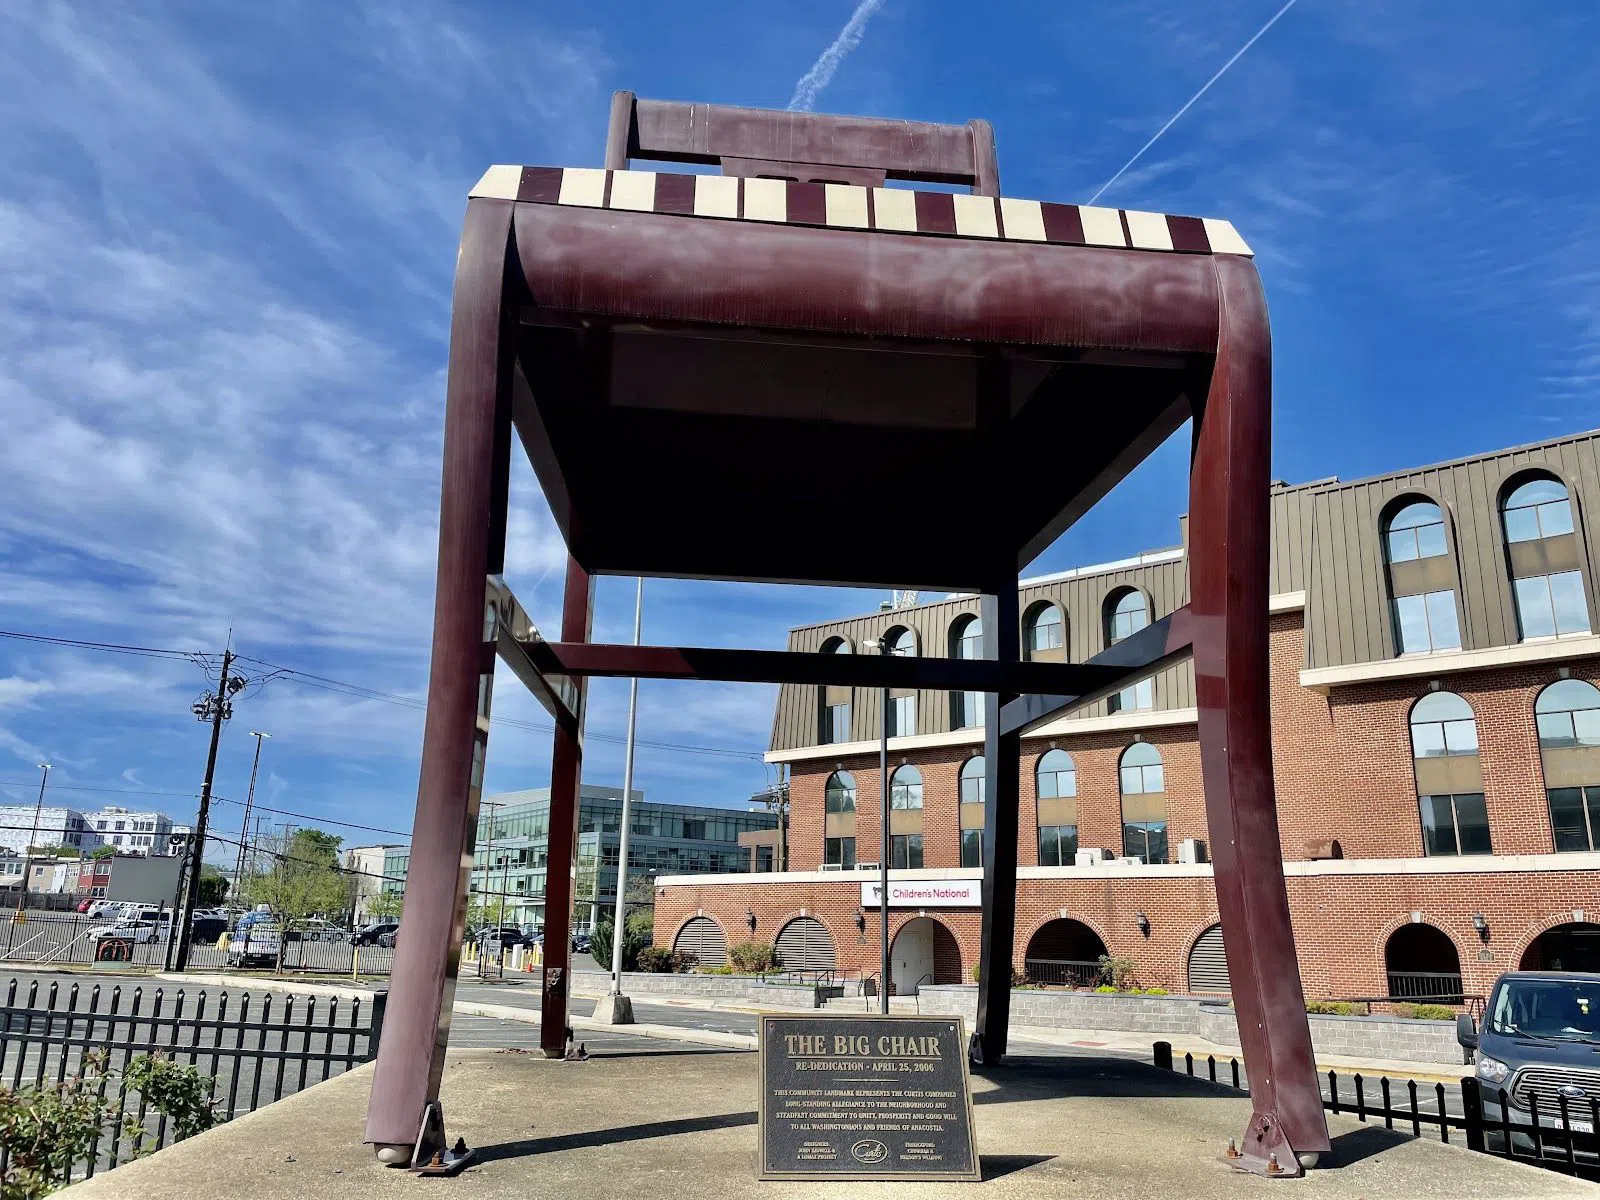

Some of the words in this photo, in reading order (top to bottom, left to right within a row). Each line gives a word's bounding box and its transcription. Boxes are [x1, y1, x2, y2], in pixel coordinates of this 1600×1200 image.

[893, 889, 932, 898] Children's
[933, 889, 970, 898] National
[785, 1035, 827, 1056] THE
[834, 1035, 870, 1056] BIG
[878, 1036, 942, 1056] CHAIR
[796, 1062, 864, 1071] RE-DEDICATION
[872, 1063, 897, 1072] APRIL
[899, 1063, 912, 1073] 25,
[914, 1063, 934, 1072] 2006
